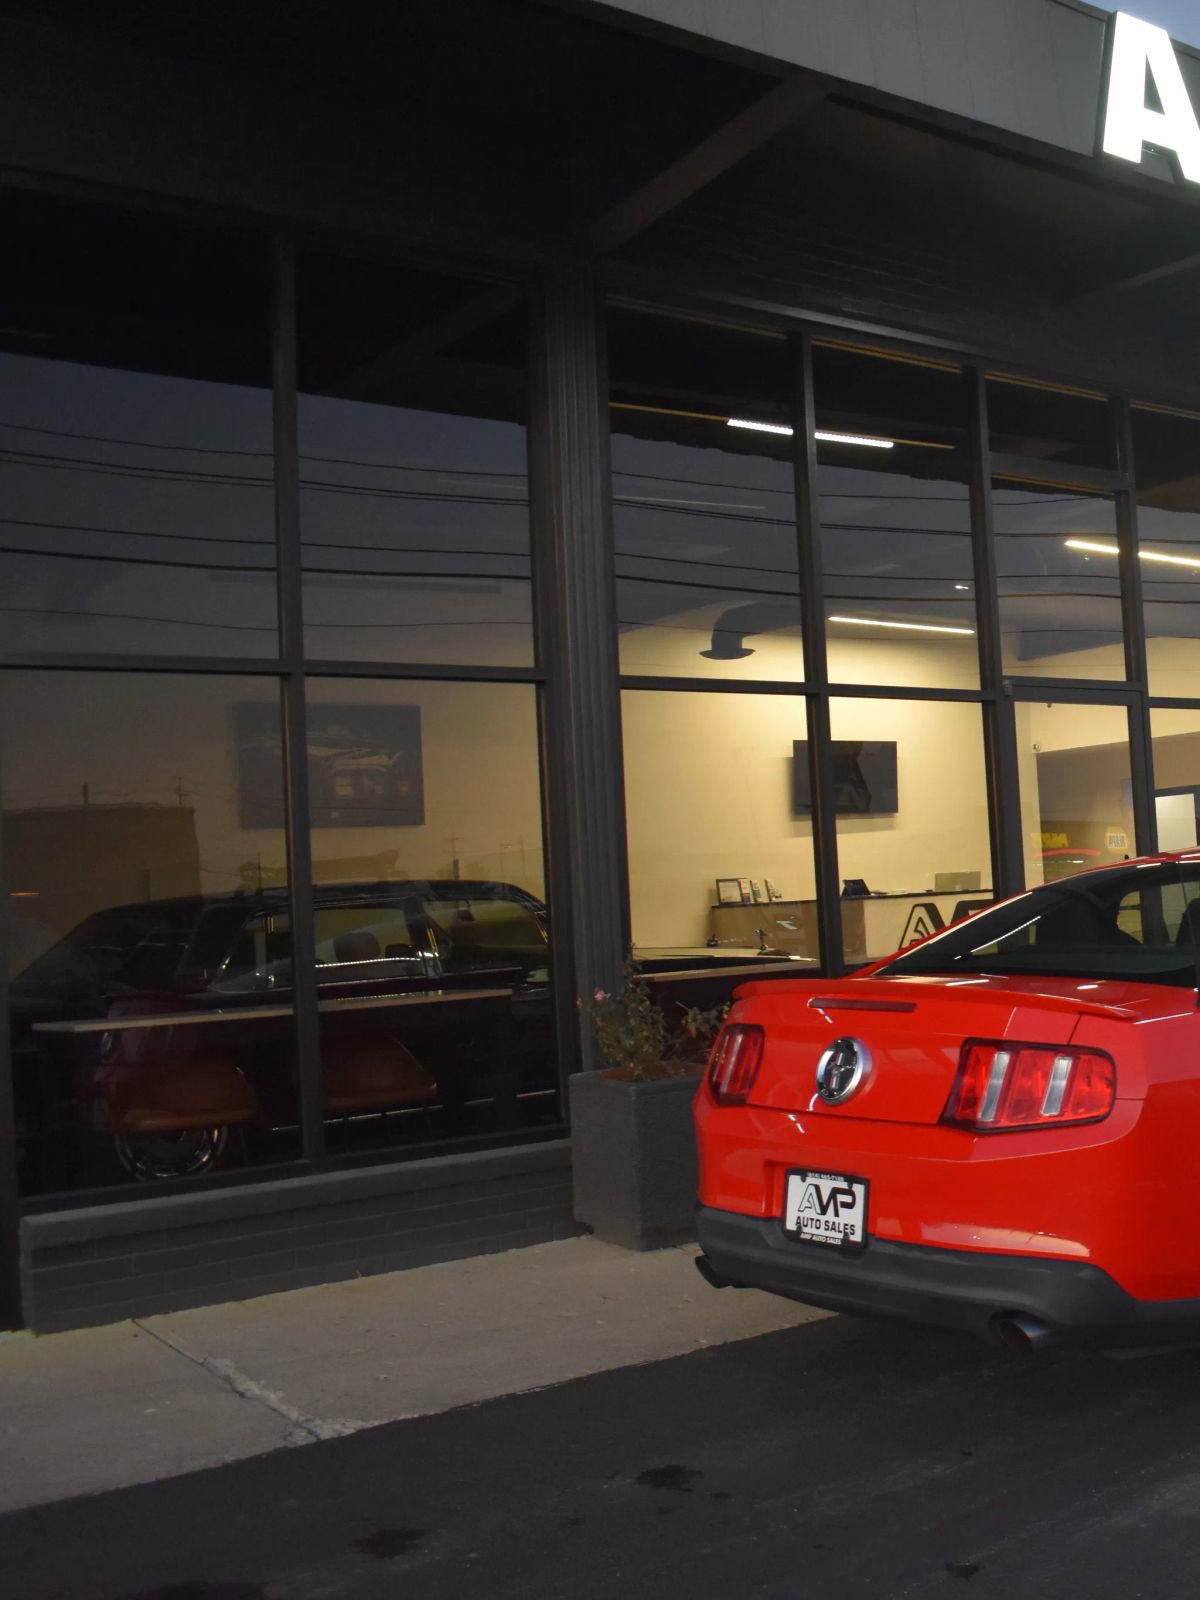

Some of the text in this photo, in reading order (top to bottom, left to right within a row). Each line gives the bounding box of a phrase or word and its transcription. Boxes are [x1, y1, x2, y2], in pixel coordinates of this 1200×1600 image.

[798, 1183, 856, 1218] AMP
[795, 1215, 856, 1236] AUTO SALES
